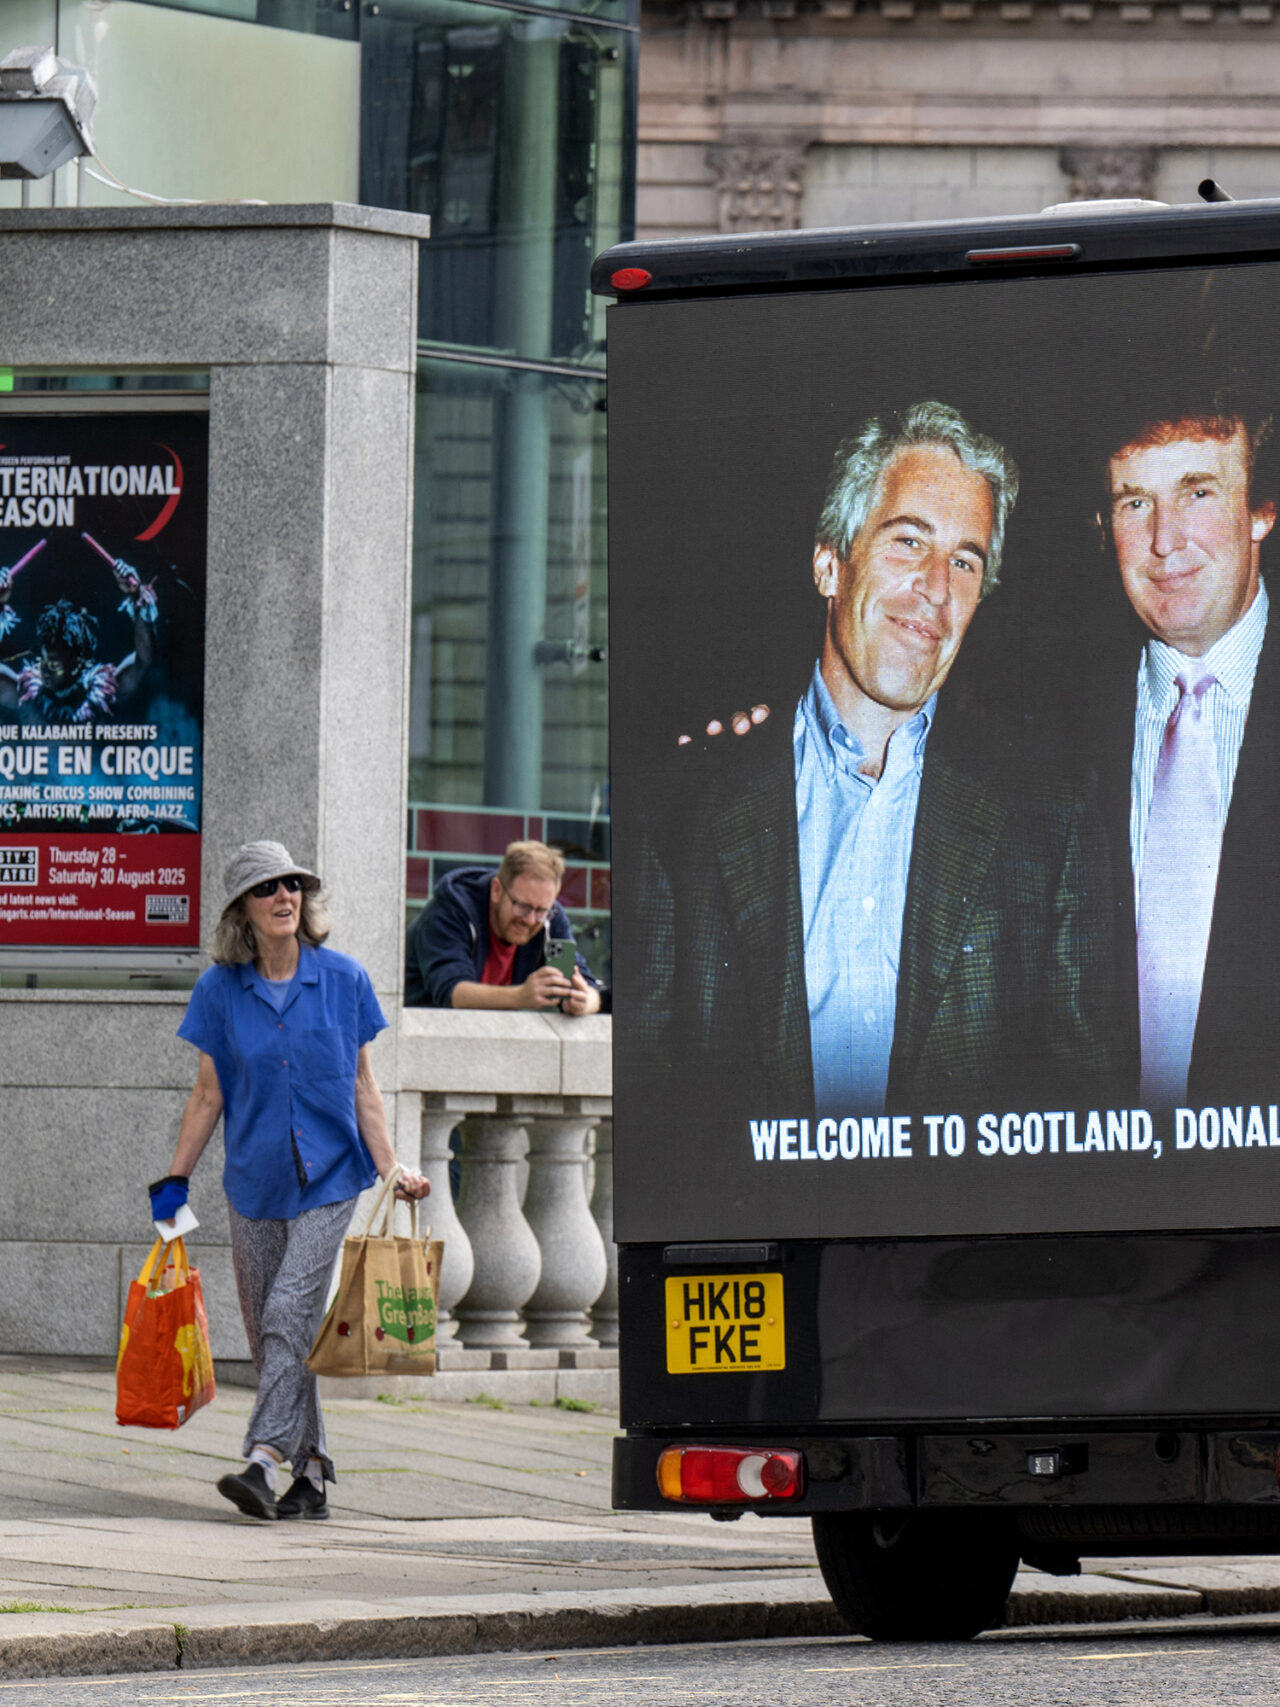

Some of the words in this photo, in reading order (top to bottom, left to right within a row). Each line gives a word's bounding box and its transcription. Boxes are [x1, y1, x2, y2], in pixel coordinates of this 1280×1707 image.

[0, 465, 181, 496] TERNATIONAL
[0, 724, 18, 742] UE
[21, 722, 93, 741] KALABANTÉ
[95, 724, 158, 740] PRESENTS
[0, 745, 49, 780] QUE
[58, 745, 92, 775] EN
[100, 745, 194, 780] CIRQUE
[43, 785, 85, 800] CIRCUS
[88, 786, 124, 800] SHOW
[127, 786, 195, 800] COMBINING
[24, 803, 84, 822] ARTISTRY,
[88, 803, 114, 819] AND
[117, 803, 187, 819] AFRO-JAZZ.
[49, 846, 99, 868] Thursday
[102, 846, 116, 864] 28
[0, 868, 34, 881] ATRE
[48, 867, 98, 888] Saturday
[100, 868, 114, 884] 30
[117, 868, 155, 888] August
[158, 868, 185, 885] 2025
[9, 893, 33, 905] latest
[35, 895, 56, 905] news
[58, 893, 78, 905] visit:
[749, 1116, 912, 1161] WELCOME
[922, 1114, 966, 1157] TO
[976, 1108, 1163, 1158] SCOTLAND,
[683, 1281, 766, 1321] HK18
[689, 1324, 762, 1364] FKE
